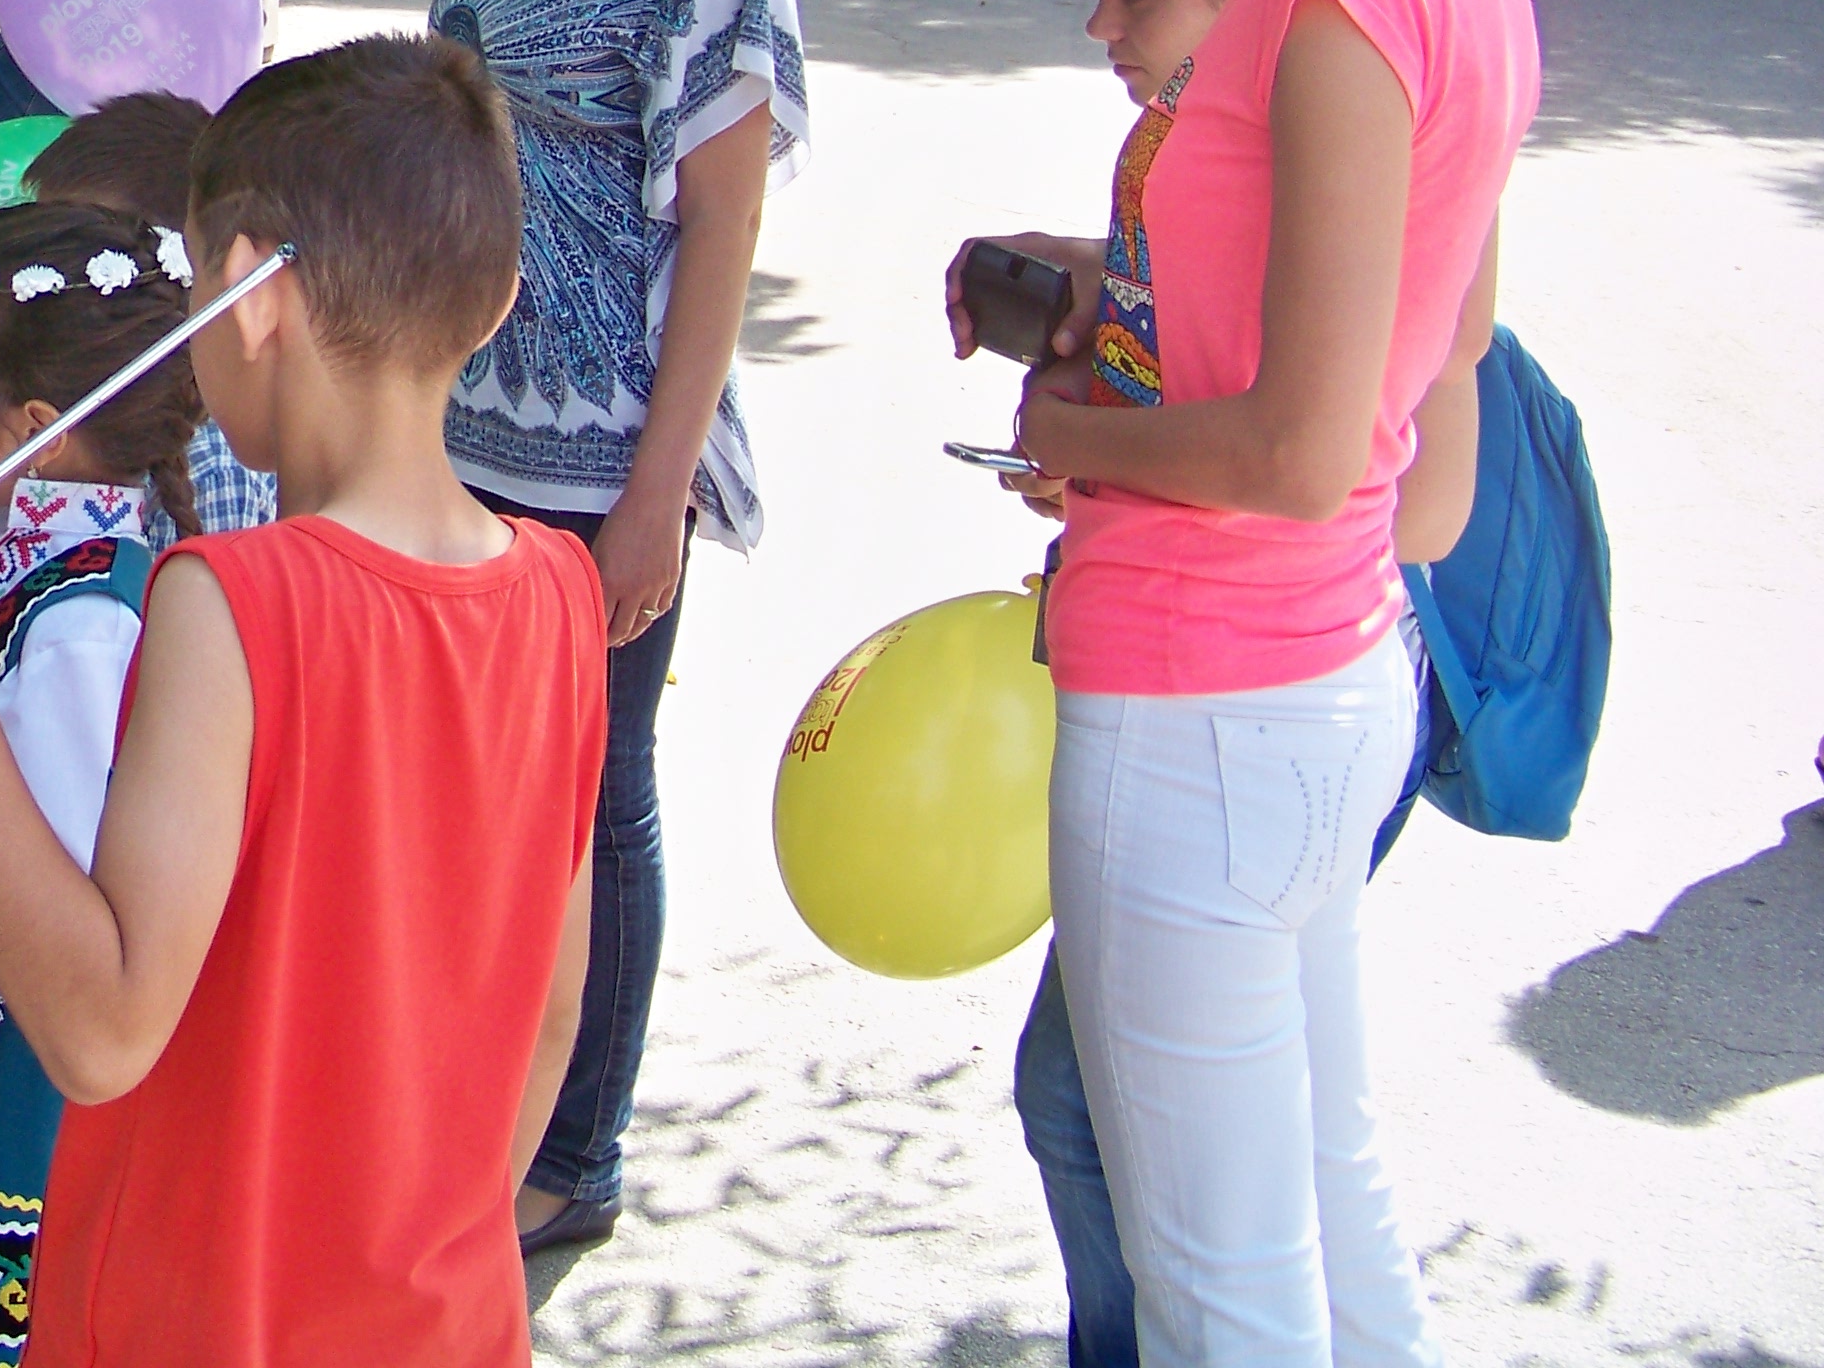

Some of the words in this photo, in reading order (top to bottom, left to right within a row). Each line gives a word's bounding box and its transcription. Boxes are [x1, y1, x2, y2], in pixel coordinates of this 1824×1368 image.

[77, 22, 144, 75] 2019
[819, 667, 857, 693] 20
[787, 720, 836, 763] plo
